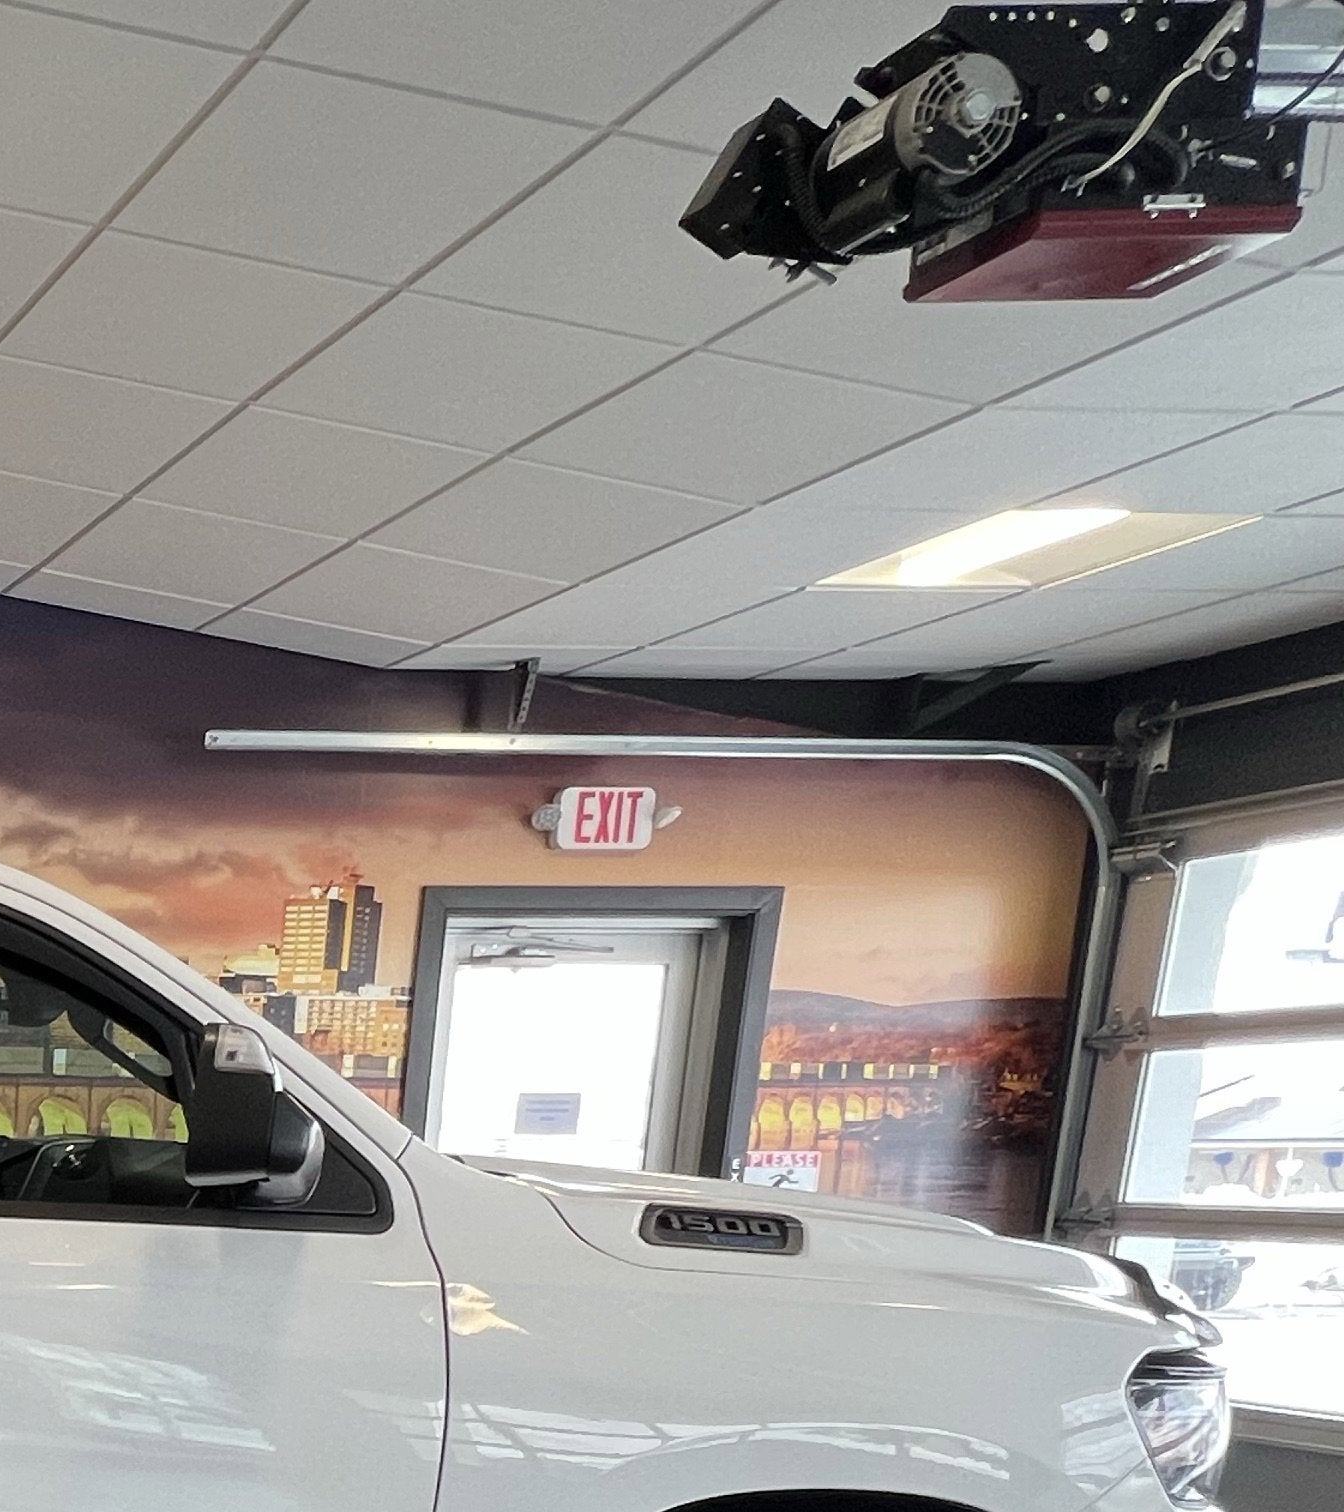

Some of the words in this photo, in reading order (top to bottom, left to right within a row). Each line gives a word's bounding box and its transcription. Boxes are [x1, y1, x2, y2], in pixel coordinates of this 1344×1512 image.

[574, 791, 644, 844] EXIT
[749, 1154, 817, 1168] PLEASE
[663, 1210, 781, 1237] 1500
